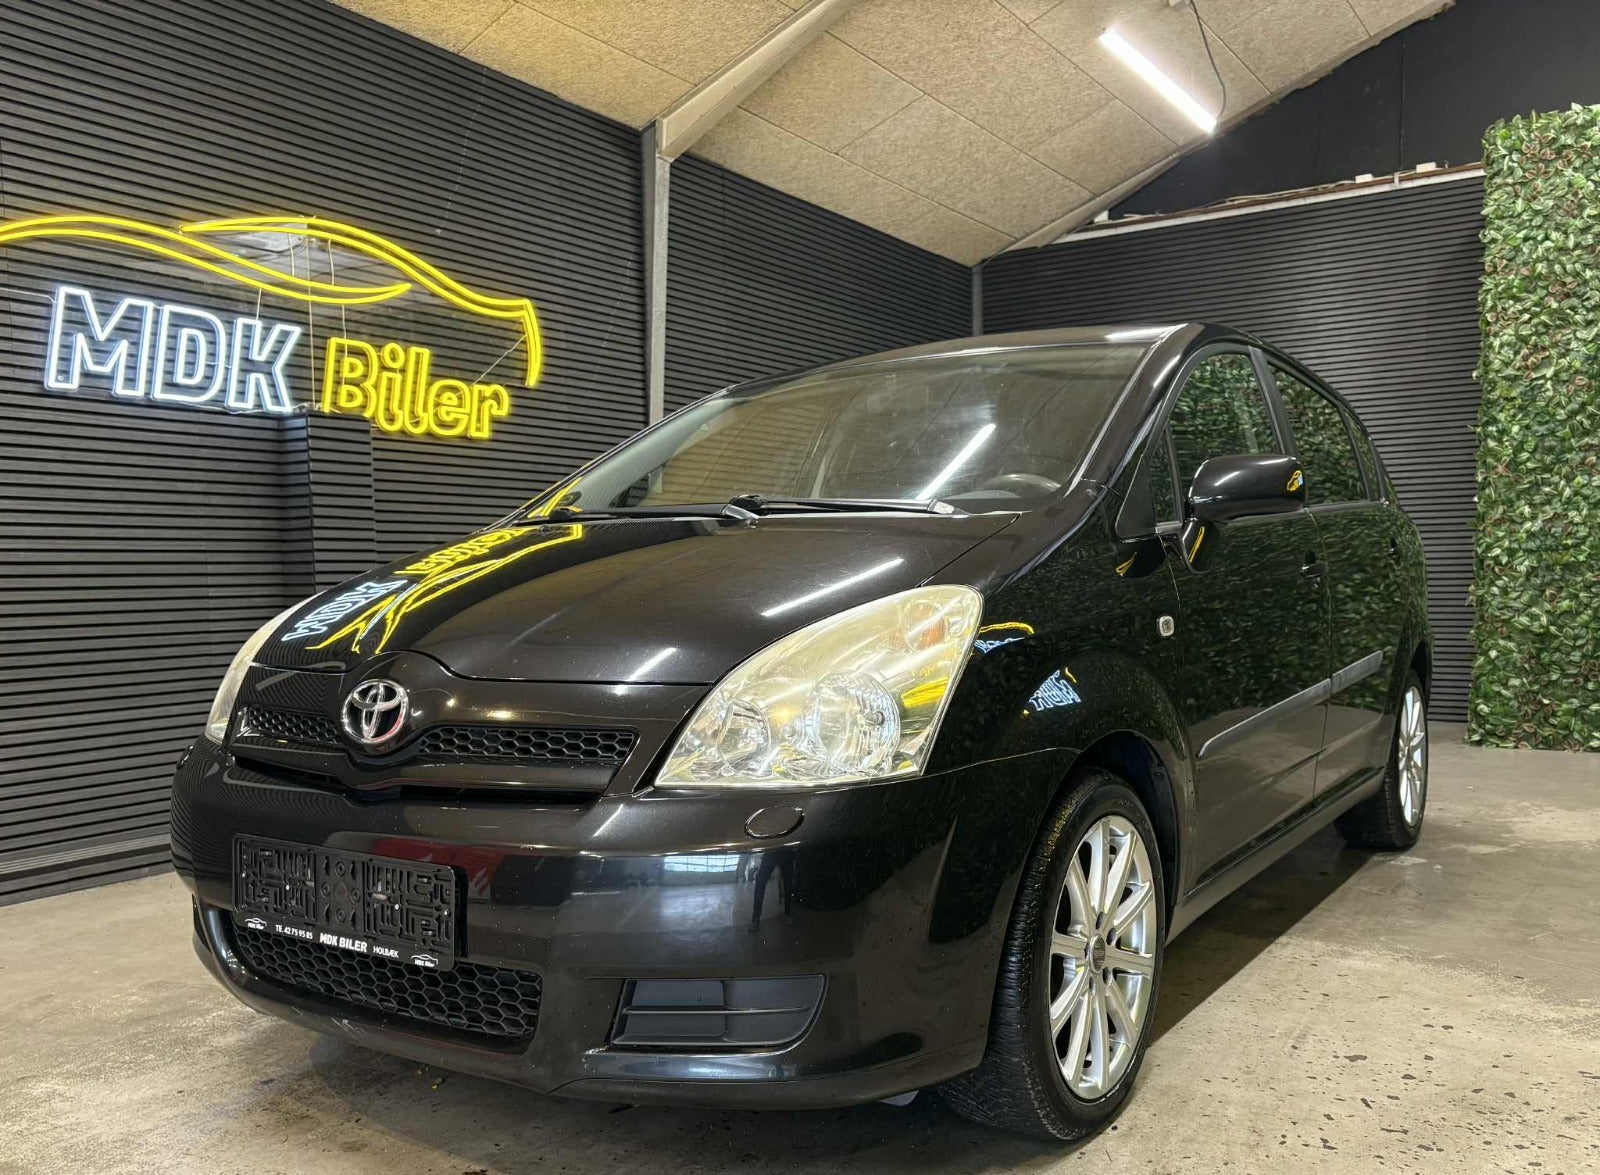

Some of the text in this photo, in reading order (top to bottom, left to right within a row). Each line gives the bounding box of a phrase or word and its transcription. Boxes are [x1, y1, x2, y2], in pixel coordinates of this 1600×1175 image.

[45, 285, 511, 440] MDK Biler
[319, 932, 338, 946] MDK
[339, 937, 367, 953] BILER
